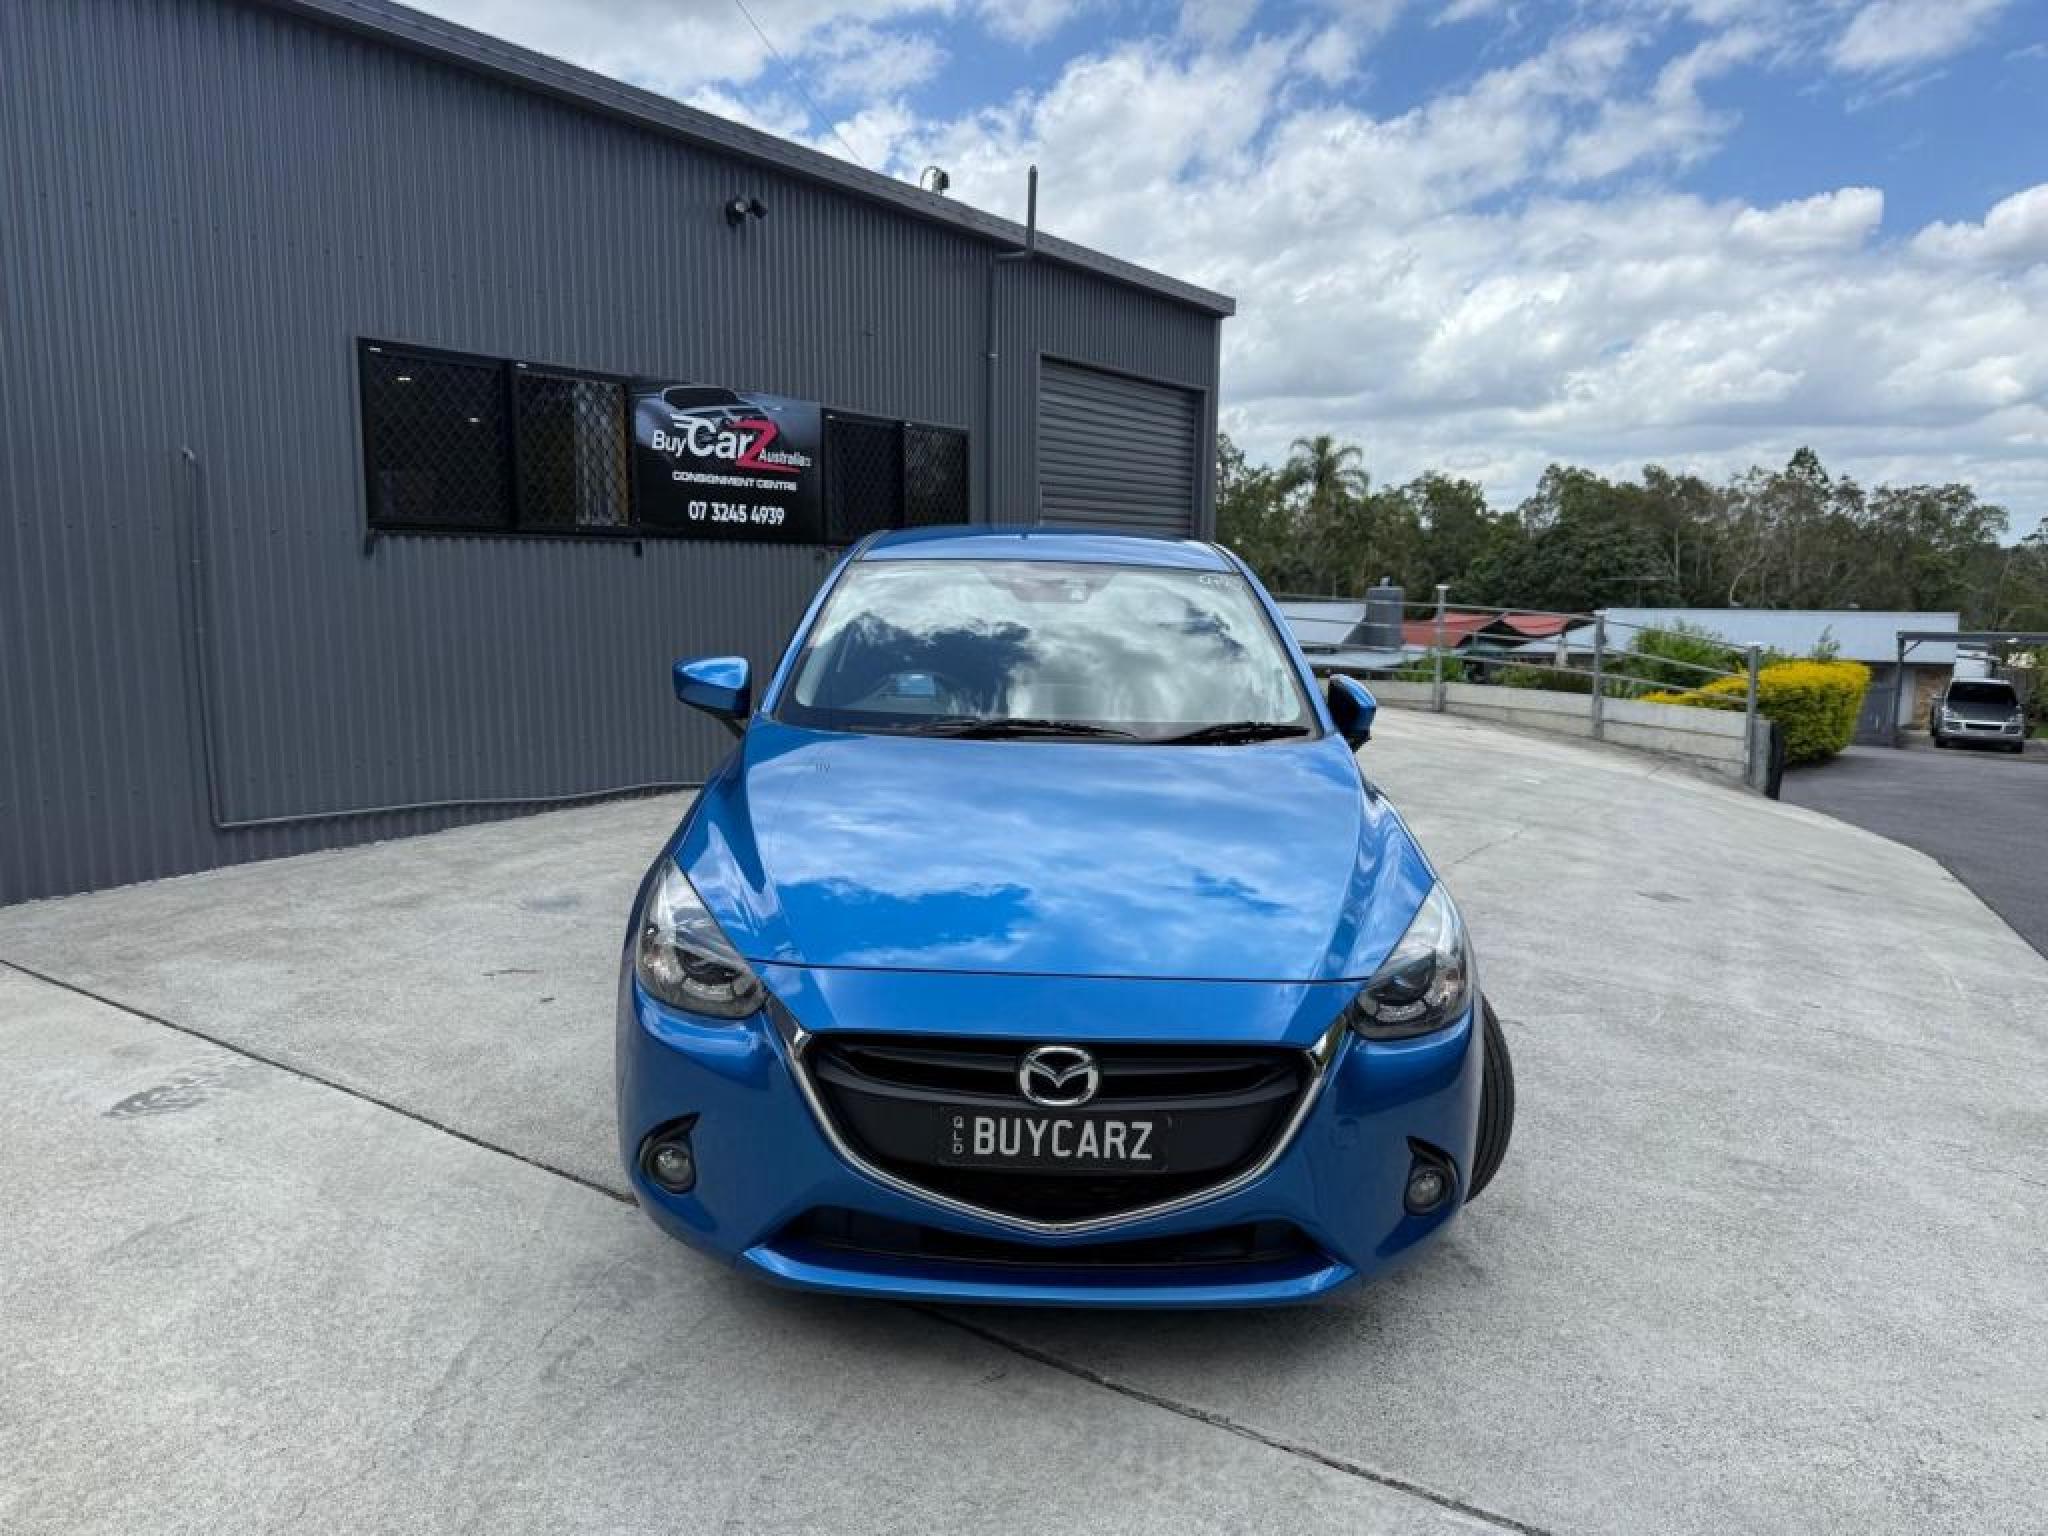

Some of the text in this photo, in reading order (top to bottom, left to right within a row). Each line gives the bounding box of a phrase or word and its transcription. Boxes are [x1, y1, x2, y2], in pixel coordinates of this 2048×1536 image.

[672, 471, 797, 492] CONSIGNMENT CENTRE
[689, 501, 785, 525] 07 3245 4939
[953, 1115, 964, 1155] QLD
[974, 1117, 1153, 1161] BUYCARZ
